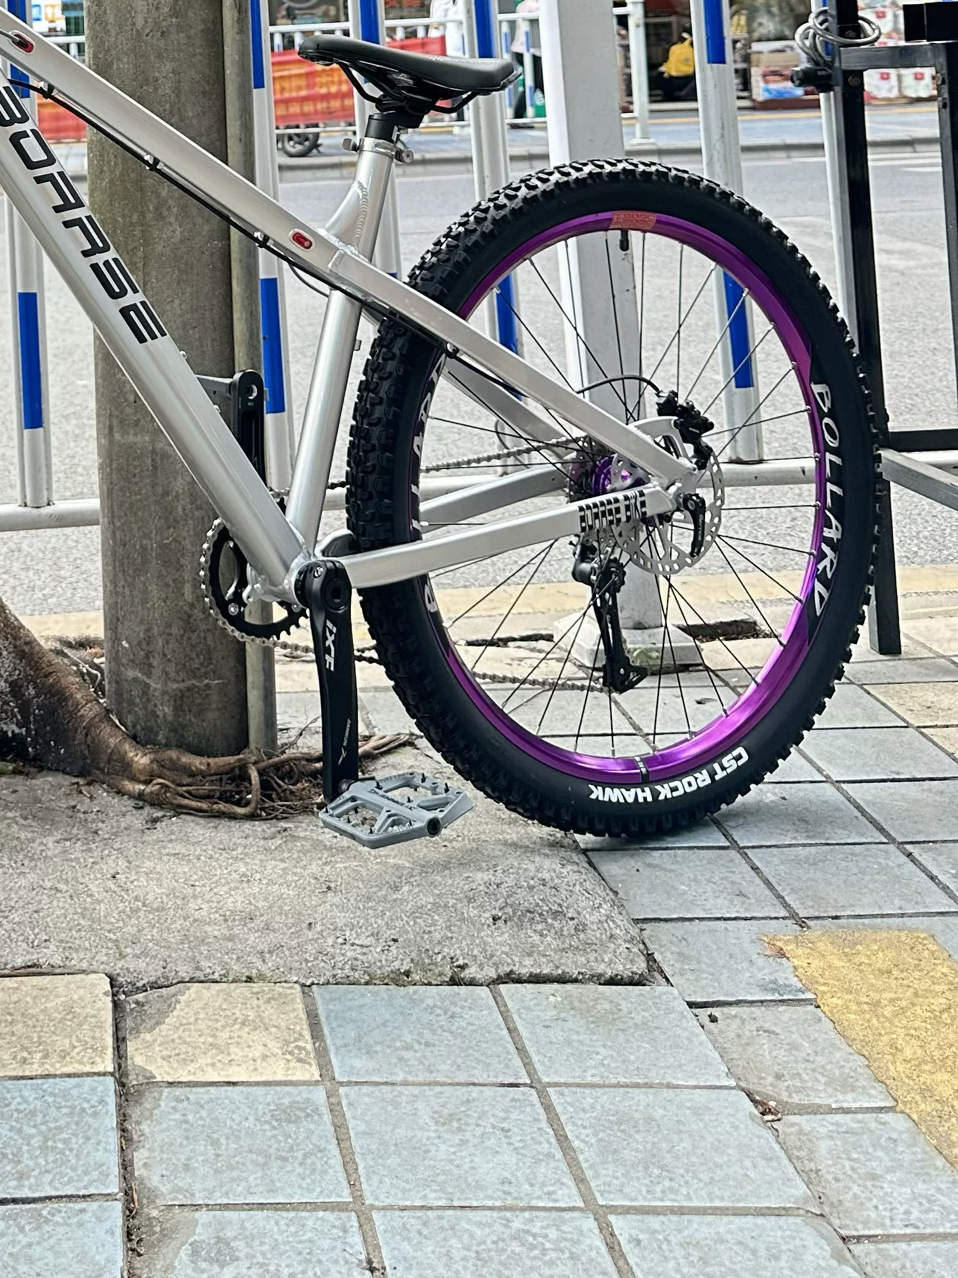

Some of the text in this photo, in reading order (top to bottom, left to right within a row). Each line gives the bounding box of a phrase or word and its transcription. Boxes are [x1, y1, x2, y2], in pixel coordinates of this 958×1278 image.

[623, 489, 647, 523] BIKE
[810, 381, 844, 617] BOLLARD
[588, 746, 749, 803] CST ROCK HAWK
